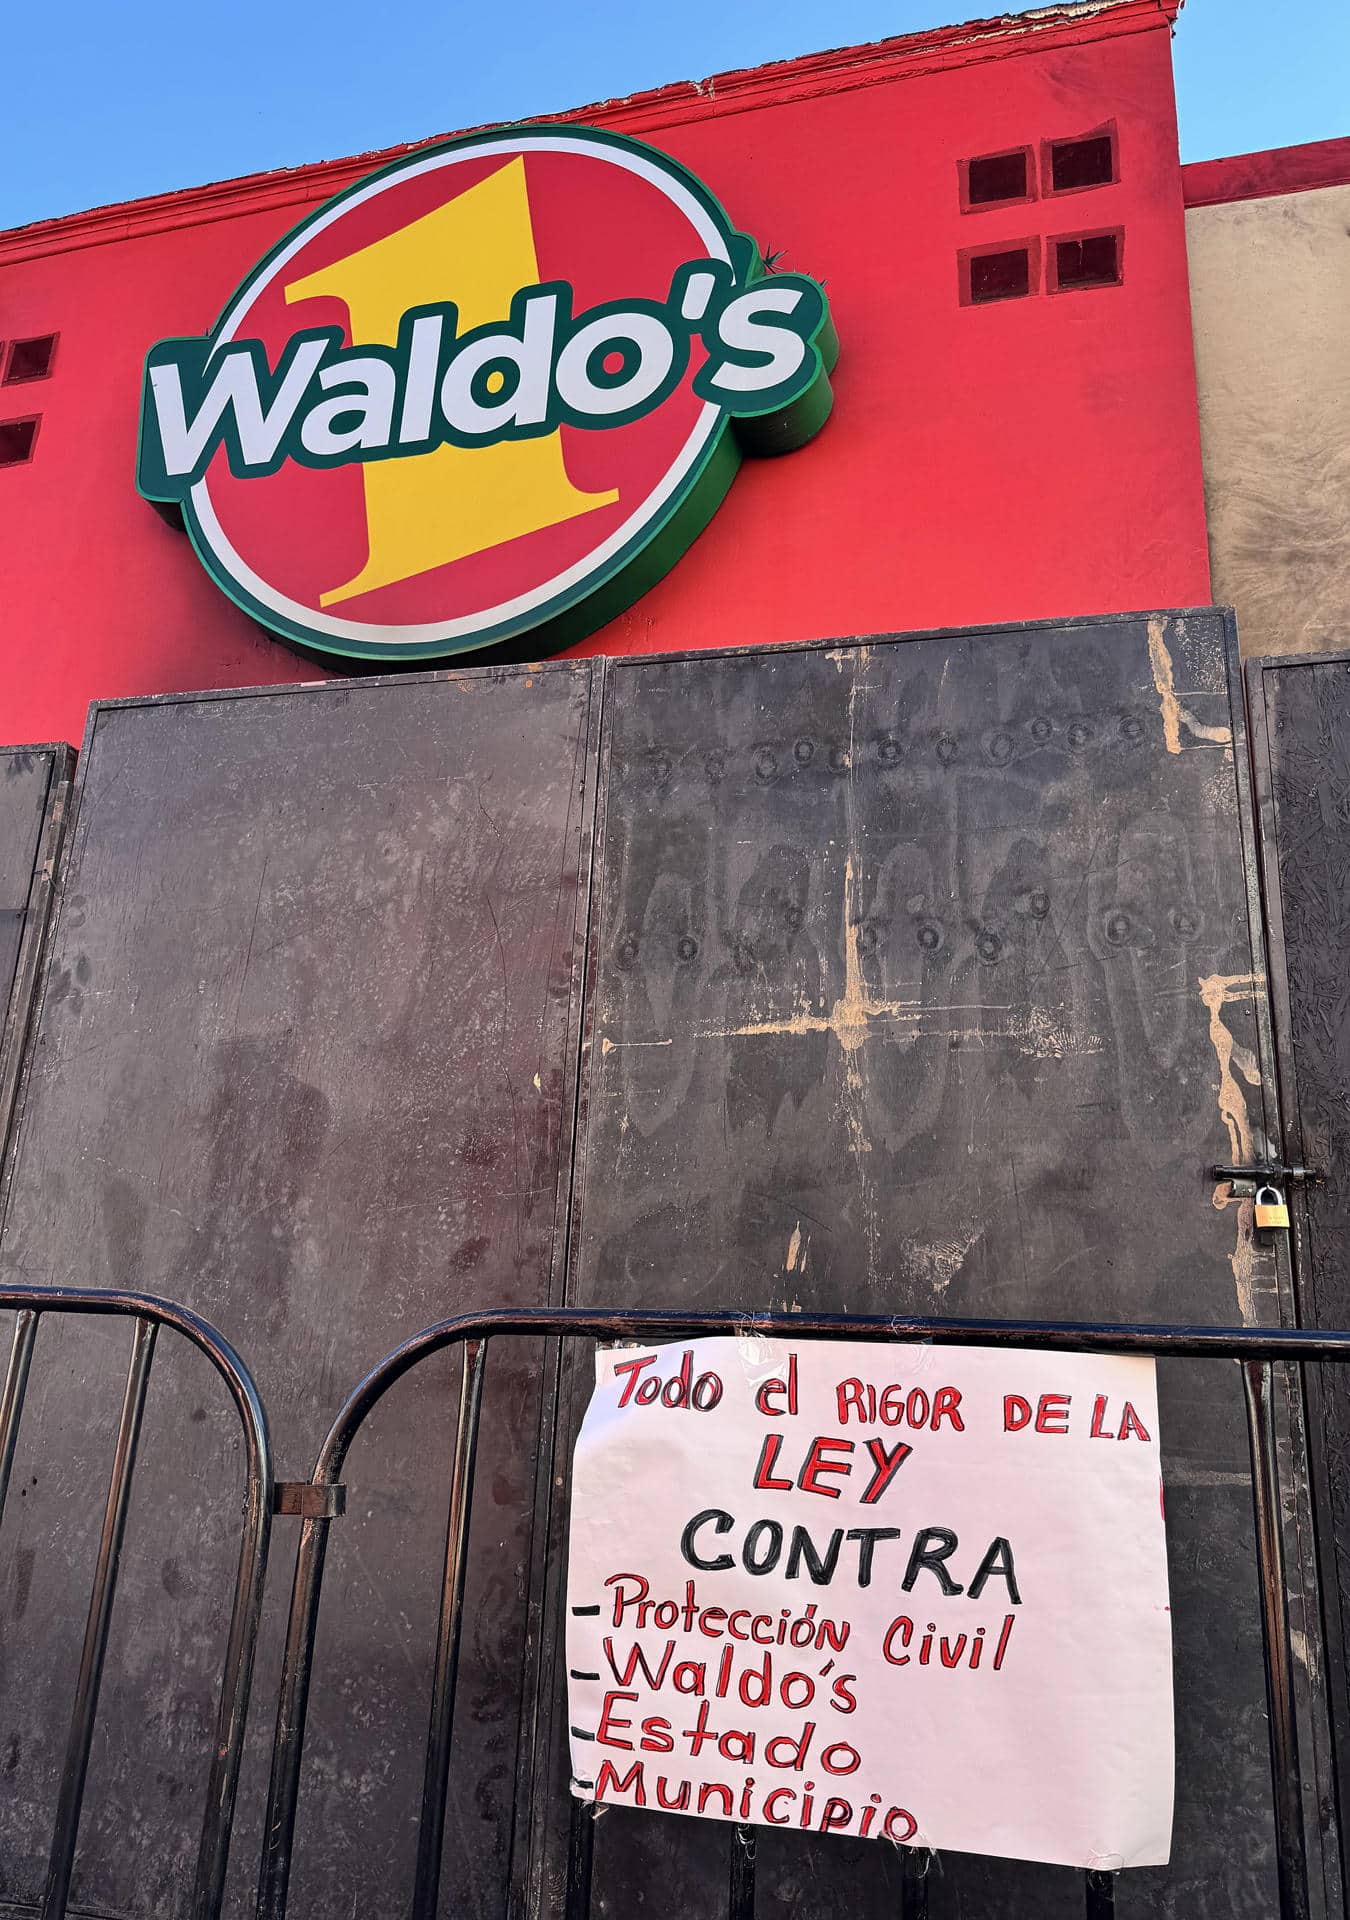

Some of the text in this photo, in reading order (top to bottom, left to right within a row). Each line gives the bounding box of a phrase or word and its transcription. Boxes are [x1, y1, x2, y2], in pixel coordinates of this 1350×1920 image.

[148, 272, 805, 477] Waldo's
[614, 1350, 1151, 1441] Todo el RIGOR DE LA
[753, 1433, 913, 1504] LEY
[681, 1508, 1023, 1605] CONTRA
[883, 1614, 1015, 1671] Civil
